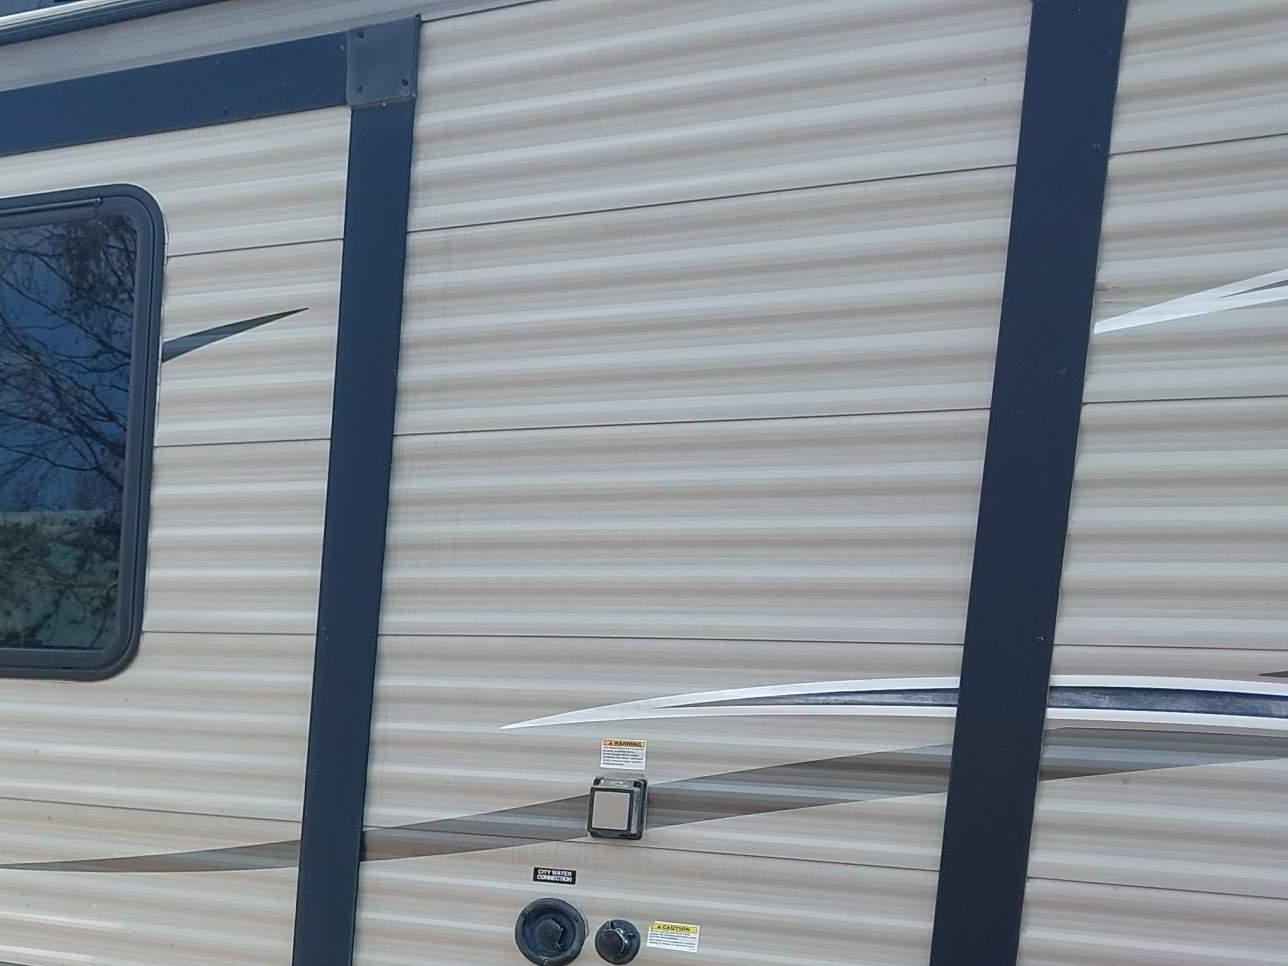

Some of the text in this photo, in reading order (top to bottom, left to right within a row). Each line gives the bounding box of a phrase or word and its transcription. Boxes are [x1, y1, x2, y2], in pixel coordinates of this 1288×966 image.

[614, 739, 642, 748] WARNING
[537, 868, 552, 876] CITY
[536, 874, 573, 883] CONNECTION
[662, 923, 691, 931] CAUTION
